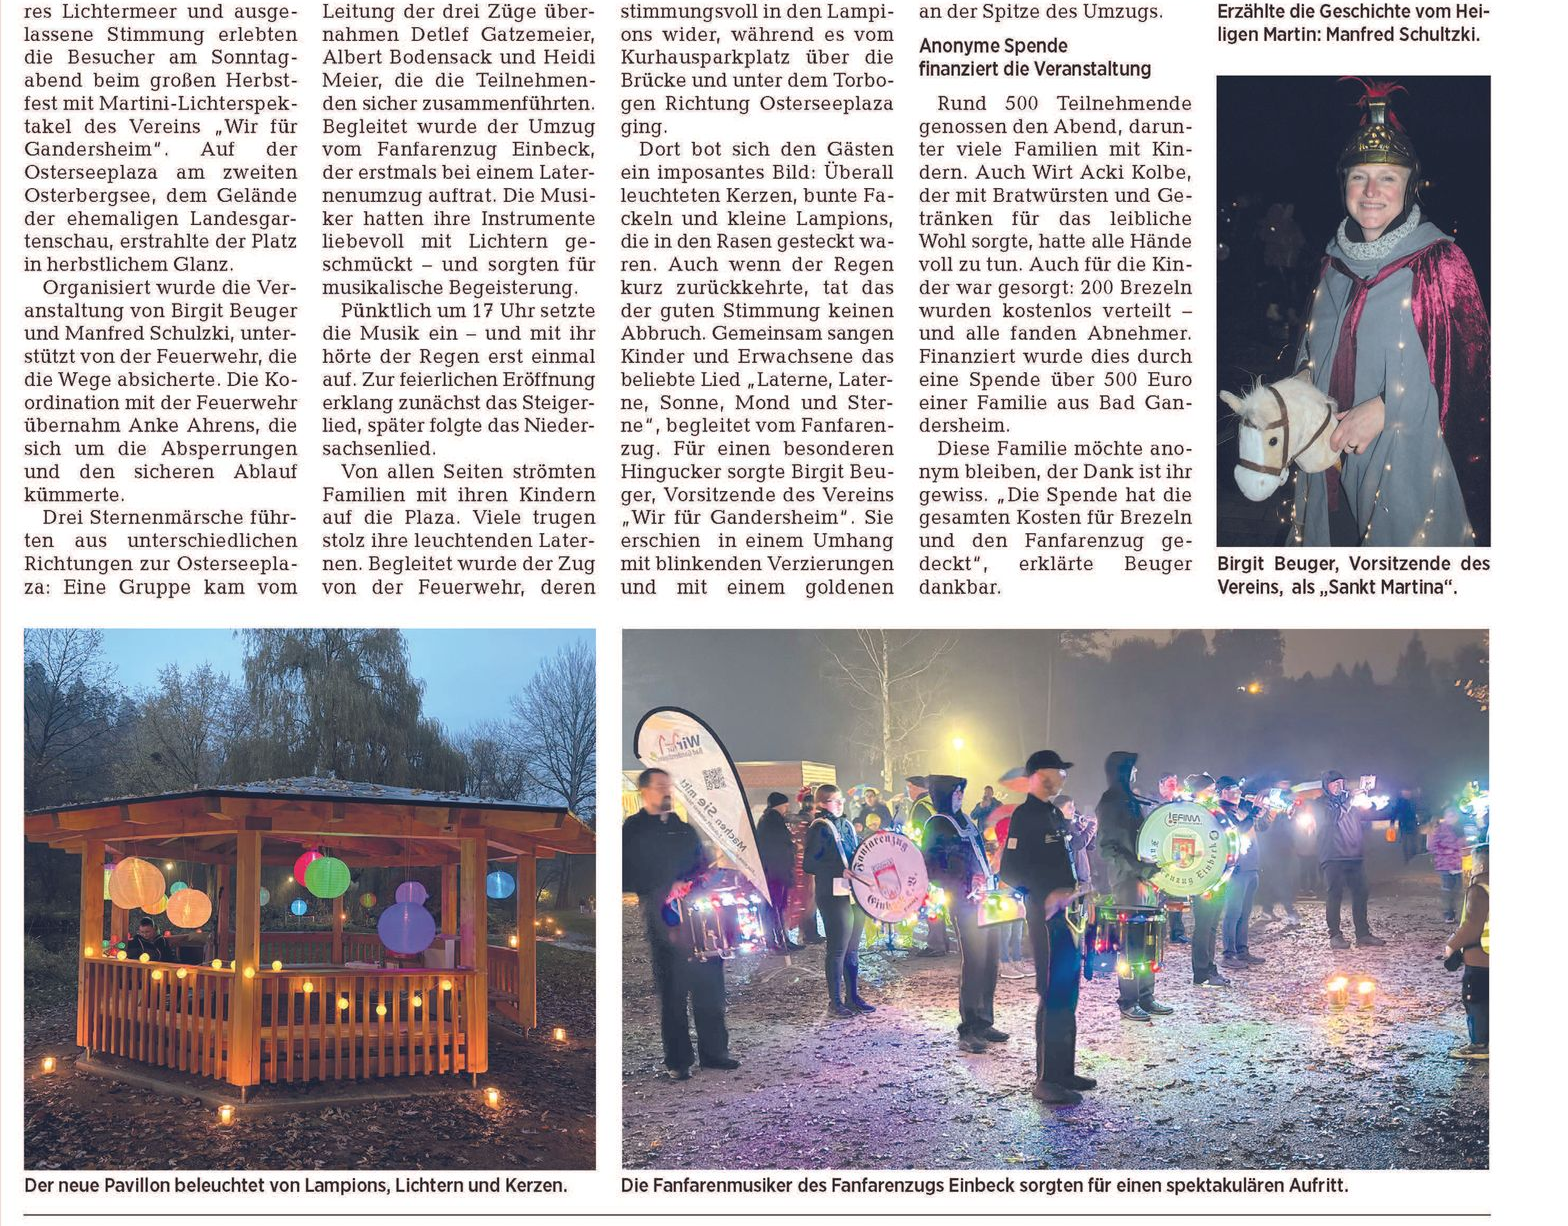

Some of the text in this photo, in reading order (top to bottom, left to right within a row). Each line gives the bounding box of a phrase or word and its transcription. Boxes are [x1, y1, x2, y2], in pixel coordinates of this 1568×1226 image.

[1218, 2, 1490, 19] Erzählte die Geschichte vom Hei-
[1218, 25, 1480, 45] ligen Martin: Manfred Schultzki.
[919, 37, 1068, 57] Anonyme Spende
[621, 48, 894, 69] Kurhausparkplatz über die
[918, 60, 1152, 80] finanziert die Veranstaltung
[937, 95, 1192, 111] Rund 500 Teilnehmende
[322, 279, 578, 299] musikalische Begeisterung.
[919, 371, 1193, 391] eine Spende über 500 Euro
[24, 417, 297, 435] übernahm Anke Ahrens, die
[1217, 555, 1491, 574] Birgit Beuger, Vorsitzende des
[1217, 578, 1284, 598] Vereins,
[1291, 578, 1316, 595] als
[24, 1176, 568, 1196] Der neue Pavillon beleuchtet von Lampions, Lichtern und Kerzen.
[621, 1176, 1349, 1196] Die Fanfarenmusiker des Fanfarenzugs Einbeck sorgten für einen spektakulären Aufritt.
